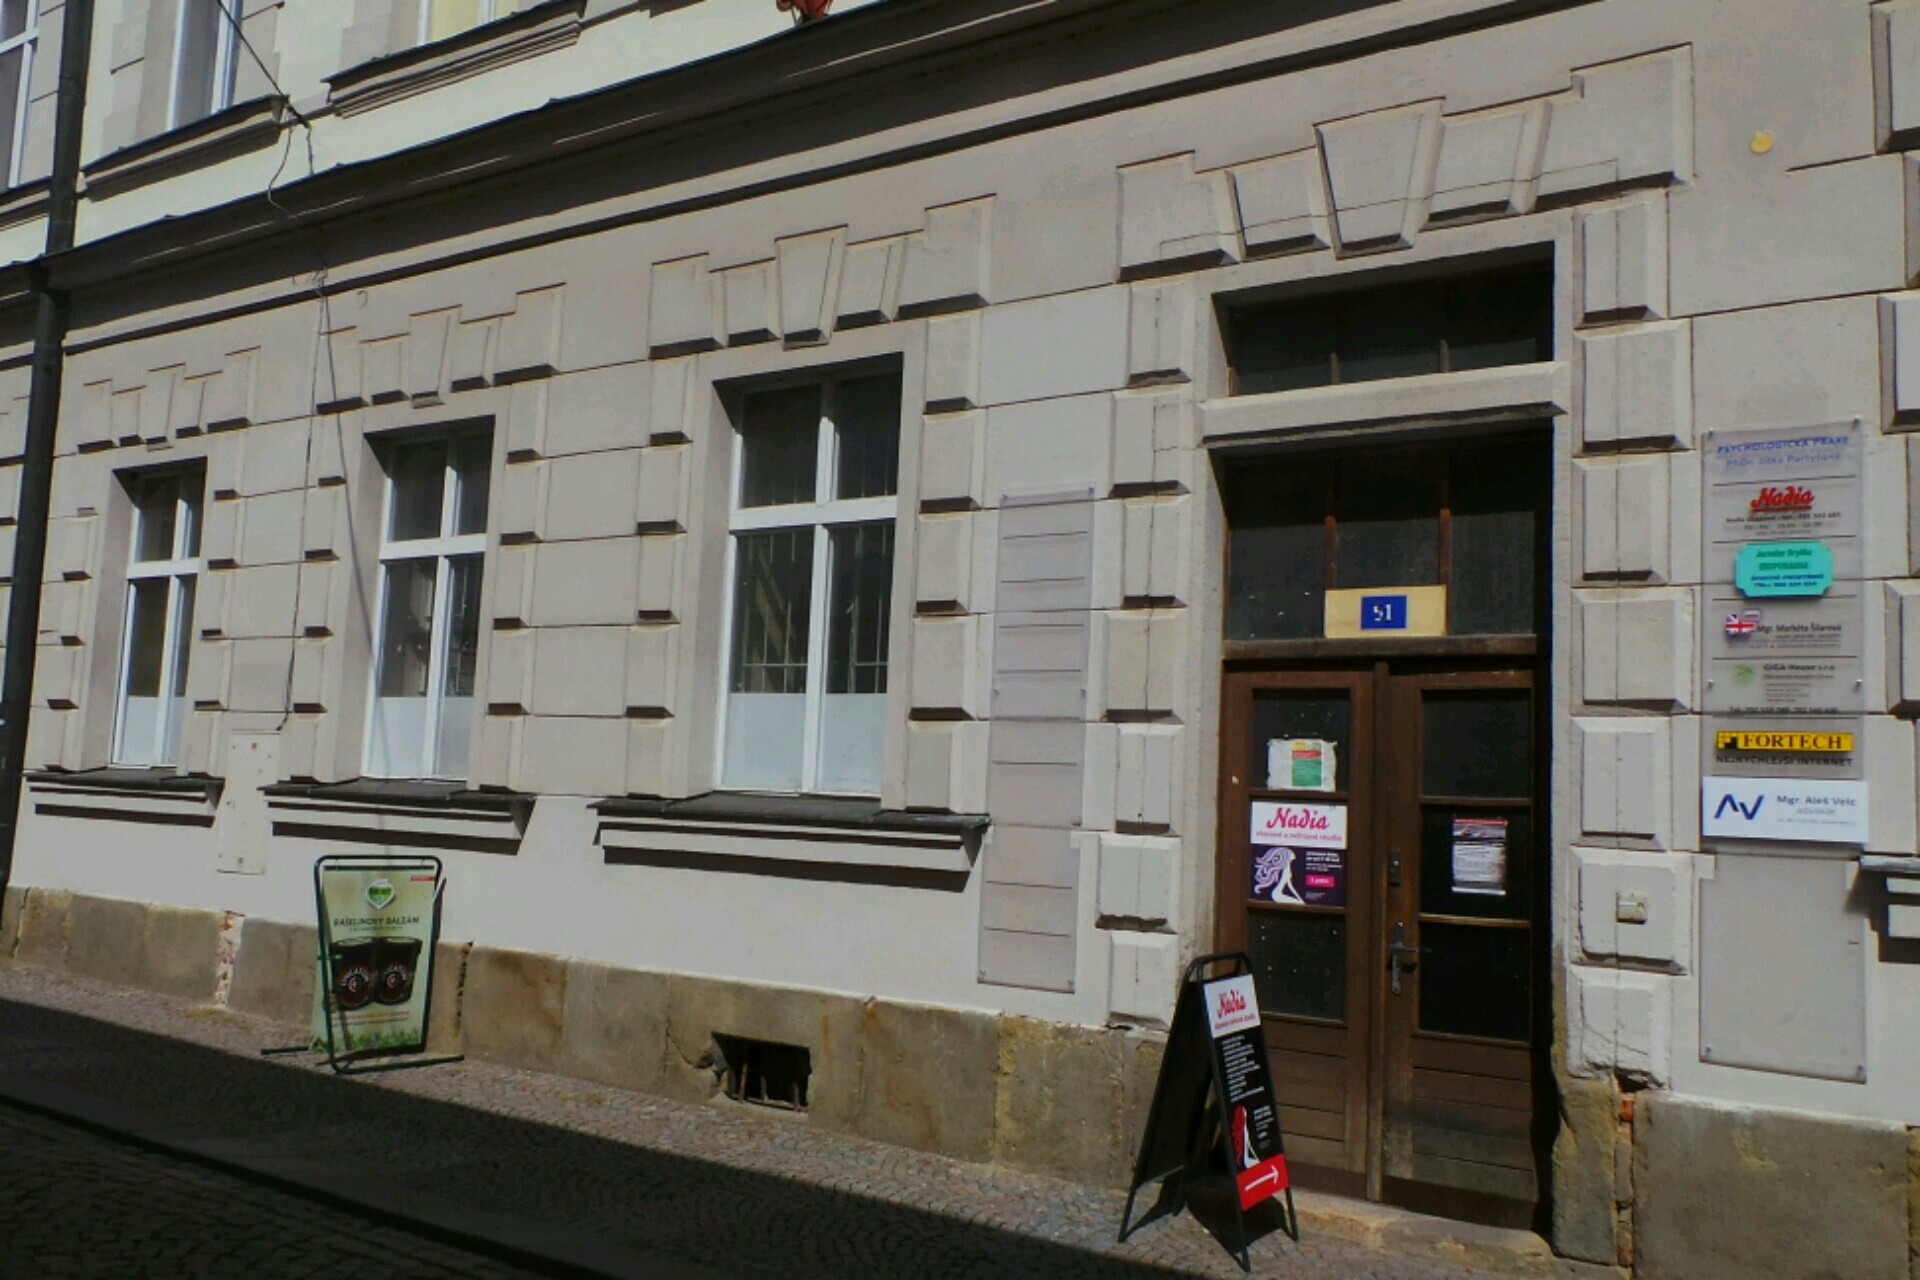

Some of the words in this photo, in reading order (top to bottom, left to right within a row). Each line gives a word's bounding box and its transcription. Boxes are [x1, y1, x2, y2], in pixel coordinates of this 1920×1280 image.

[1751, 486, 1815, 509] Nadia
[1743, 733, 1843, 750] FORTECH
[1797, 756, 1853, 767] INTERNET
[1776, 795, 1800, 805] Mgr.
[1266, 807, 1330, 830] Nadia
